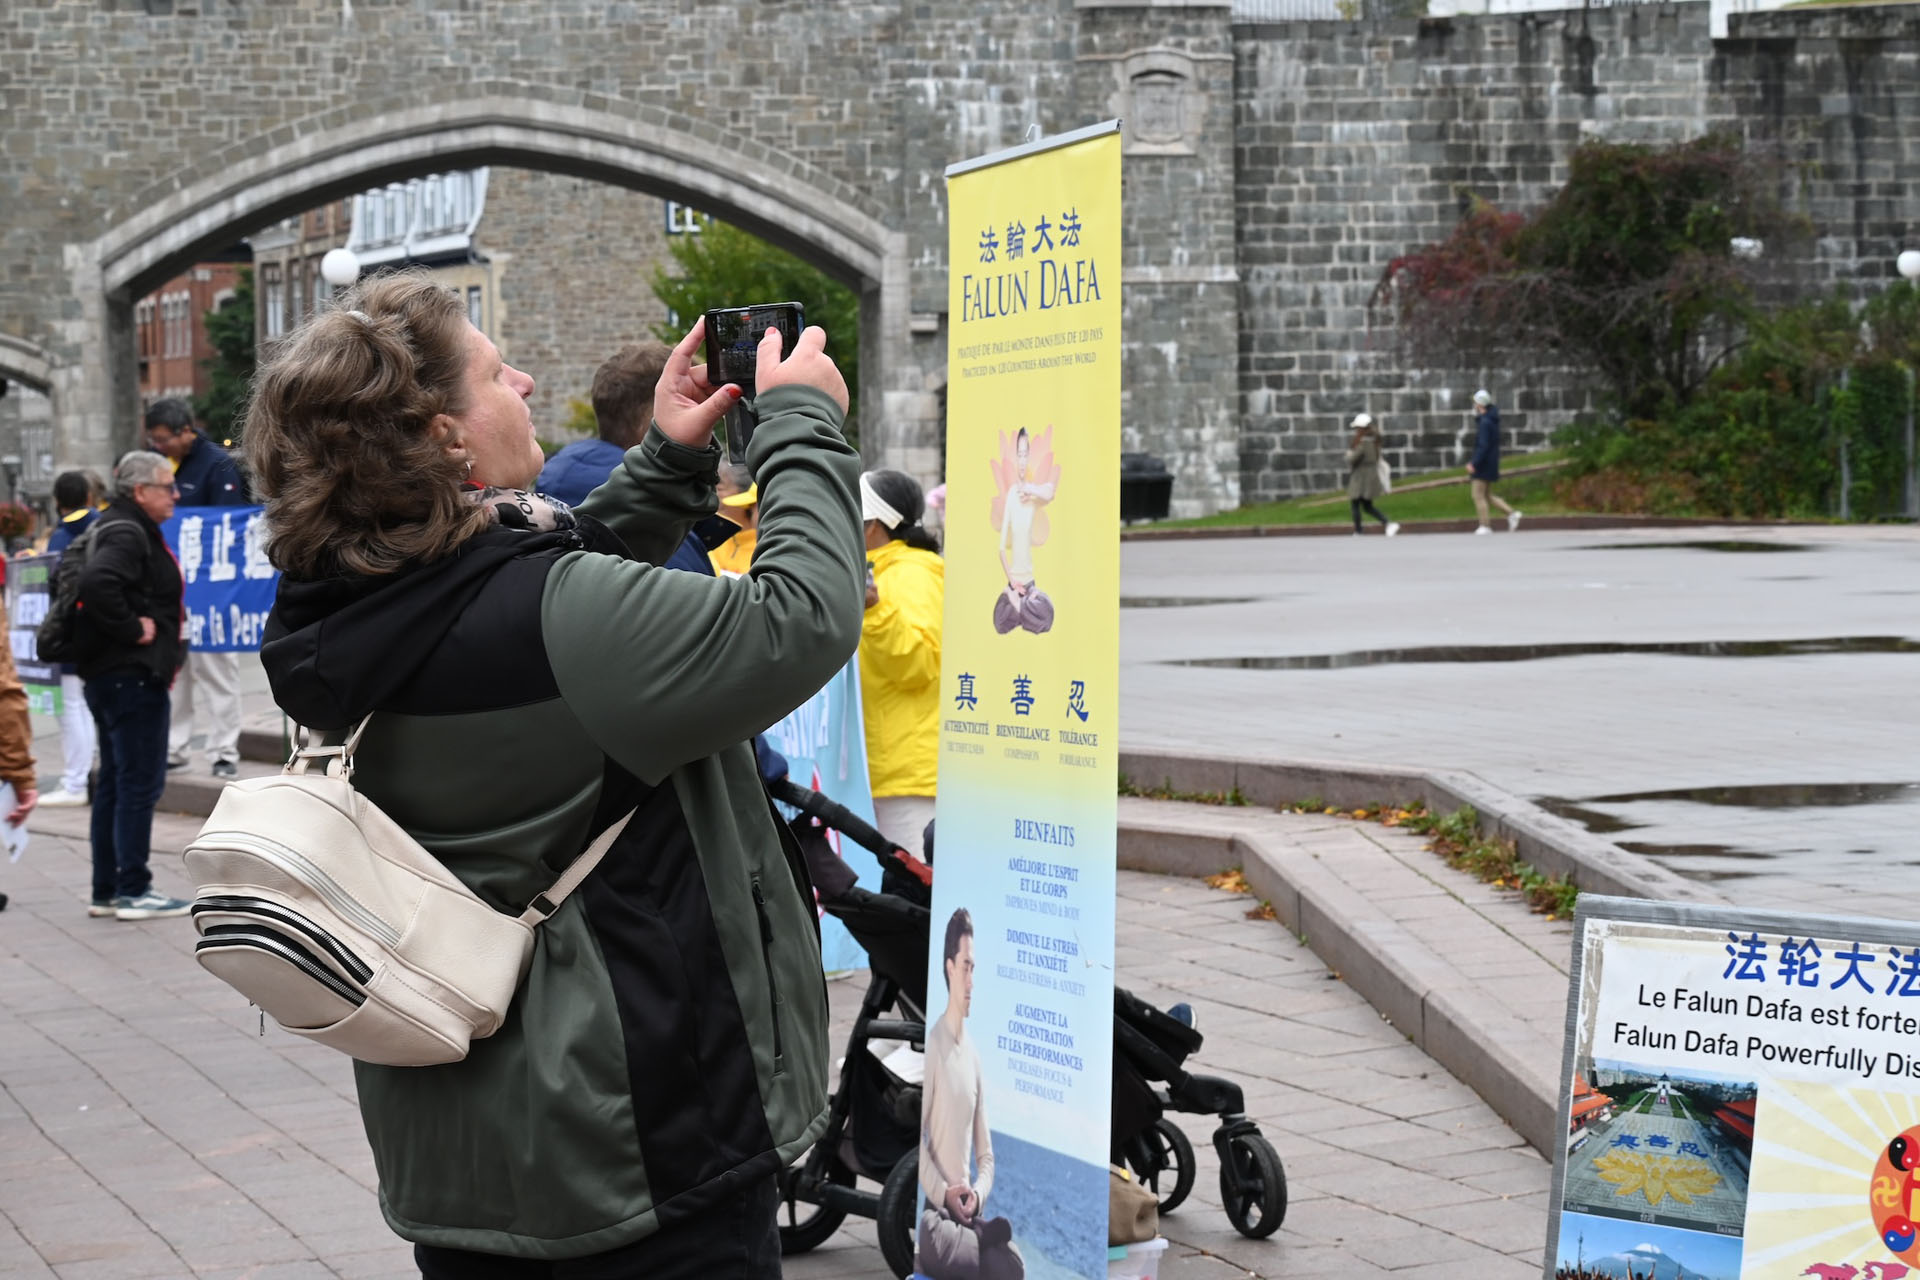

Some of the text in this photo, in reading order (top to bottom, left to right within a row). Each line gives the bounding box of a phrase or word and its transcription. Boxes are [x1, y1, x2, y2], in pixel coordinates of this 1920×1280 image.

[979, 206, 1082, 263] 法輪大法
[962, 257, 1102, 323] FALUN DAFA
[954, 672, 1090, 722] 真 善 忍
[996, 724, 1051, 742] BIENVEILLANCE
[1059, 728, 1099, 747] TOLÉRANCE
[1014, 818, 1075, 848] BIENFAITS
[1008, 856, 1079, 882] AMÉLIORE L'ESPRIT
[1020, 877, 1068, 899] ET LE CORPS
[1006, 928, 1079, 957] DIMINUE LE STRESS
[1017, 949, 1069, 973] ET L'ANXIÉTÉ
[1723, 931, 1920, 996] 法轮大法
[1028, 971, 1052, 988] STRESS
[1014, 1002, 1069, 1029] AUGMENTE LA
[1639, 984, 1920, 1036] Le Falun Dafa est forte
[1008, 1020, 1074, 1049] CONCENTRATION
[998, 1035, 1084, 1071] ET LES PERFORMANCES
[1614, 1022, 1677, 1050] Falun
[1684, 1030, 1739, 1057] Dafa
[1746, 1036, 1877, 1078] Powerfully
[1008, 1057, 1043, 1078] INCREASES
[1044, 1066, 1066, 1086] FOCUS
[1014, 1078, 1065, 1104] PERFORMANCE
